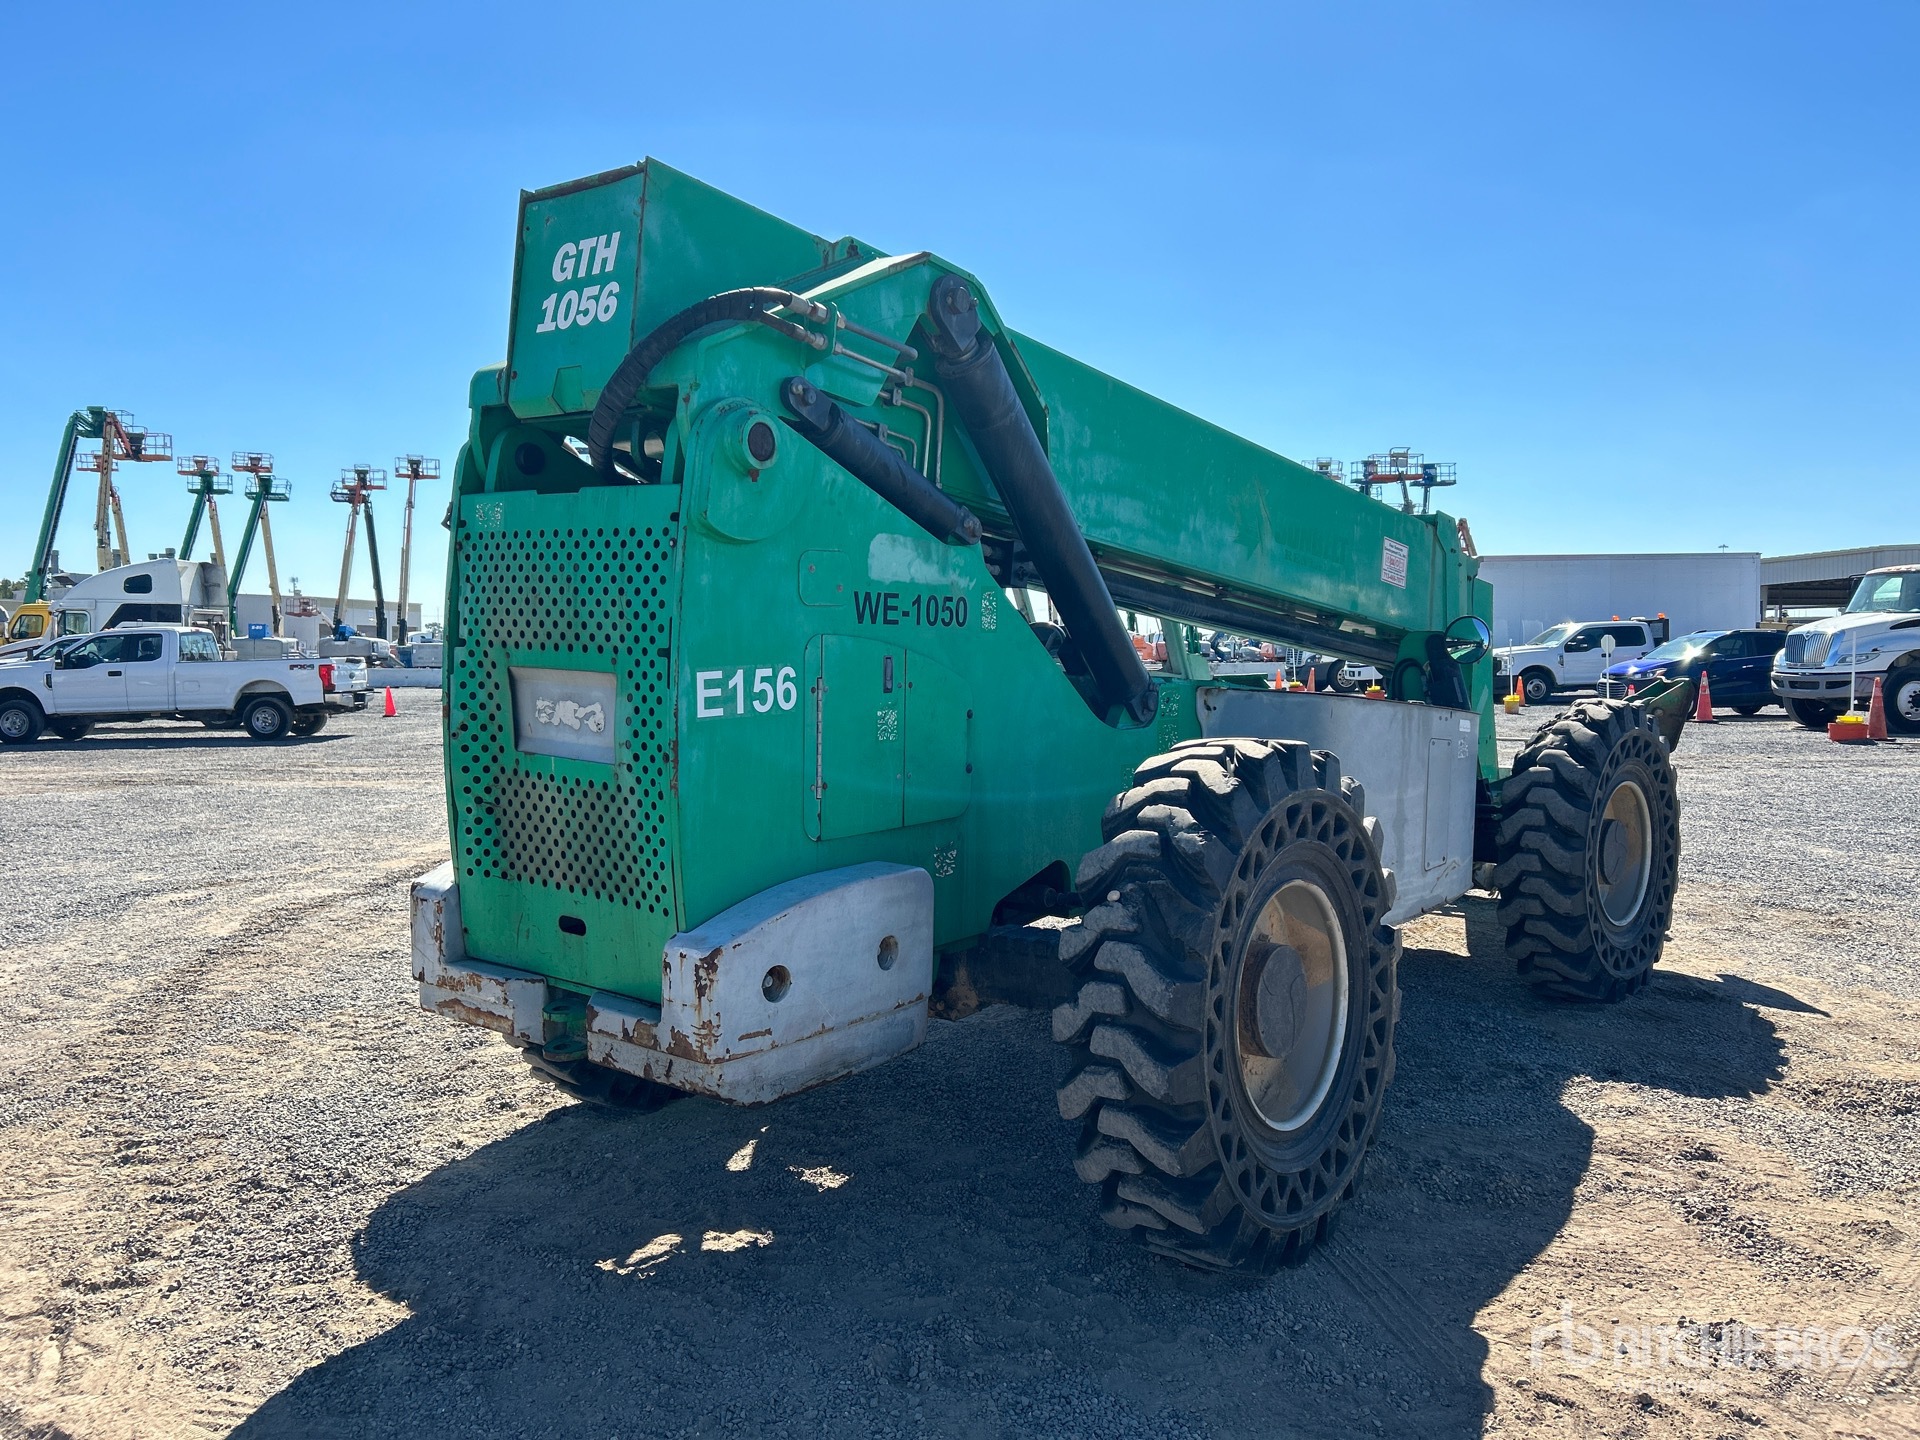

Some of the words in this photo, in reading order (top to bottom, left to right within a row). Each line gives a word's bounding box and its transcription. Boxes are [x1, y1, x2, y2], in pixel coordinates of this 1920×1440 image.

[552, 231, 621, 282] GTH
[536, 281, 620, 333] 1056
[853, 591, 969, 628] WE-1050
[696, 666, 798, 718] E156
